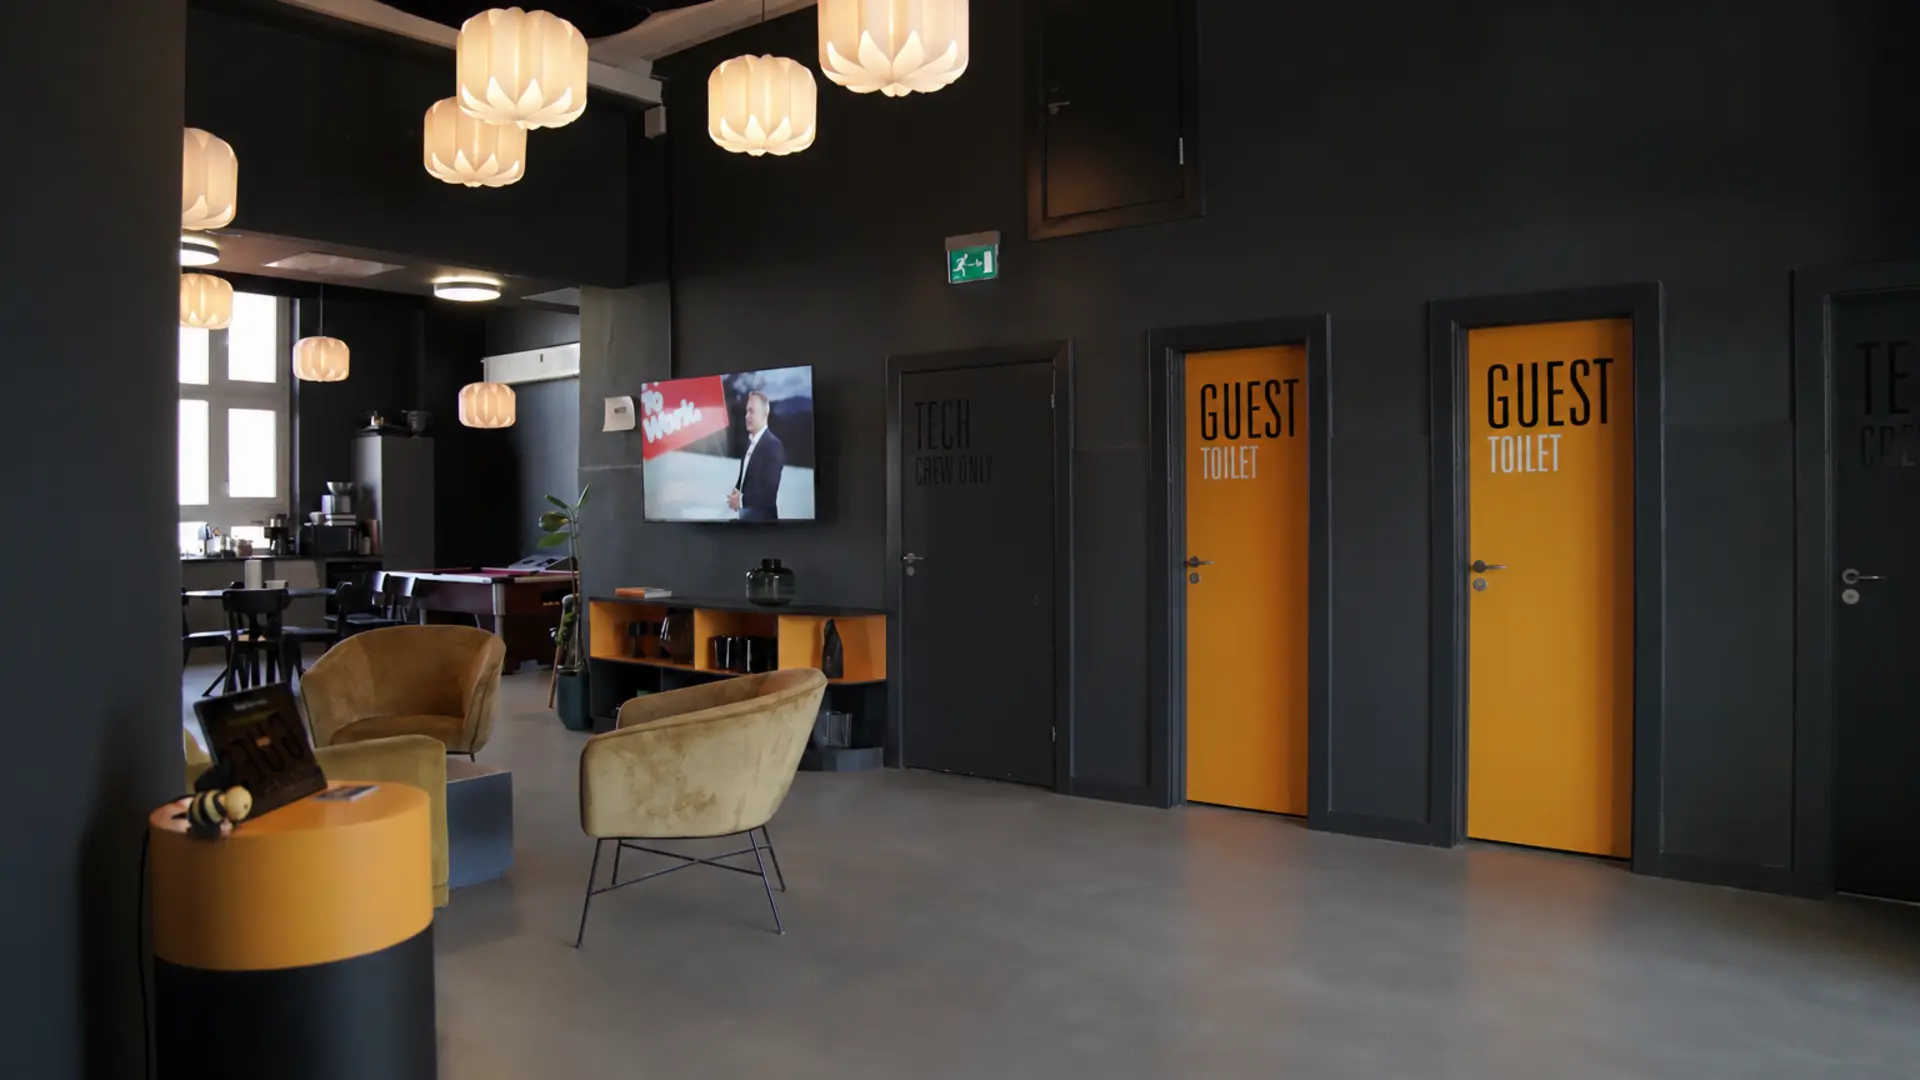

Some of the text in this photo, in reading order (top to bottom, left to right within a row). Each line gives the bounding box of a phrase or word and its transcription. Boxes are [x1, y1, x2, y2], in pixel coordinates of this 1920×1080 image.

[1200, 378, 1299, 441] GUEST
[1487, 358, 1614, 429] GUEST
[914, 398, 970, 450] TECH
[1861, 423, 1920, 467] CRE
[915, 454, 994, 486] CREW ONLY
[1200, 445, 1259, 480] TOILET
[1487, 434, 1562, 473] TOILET
